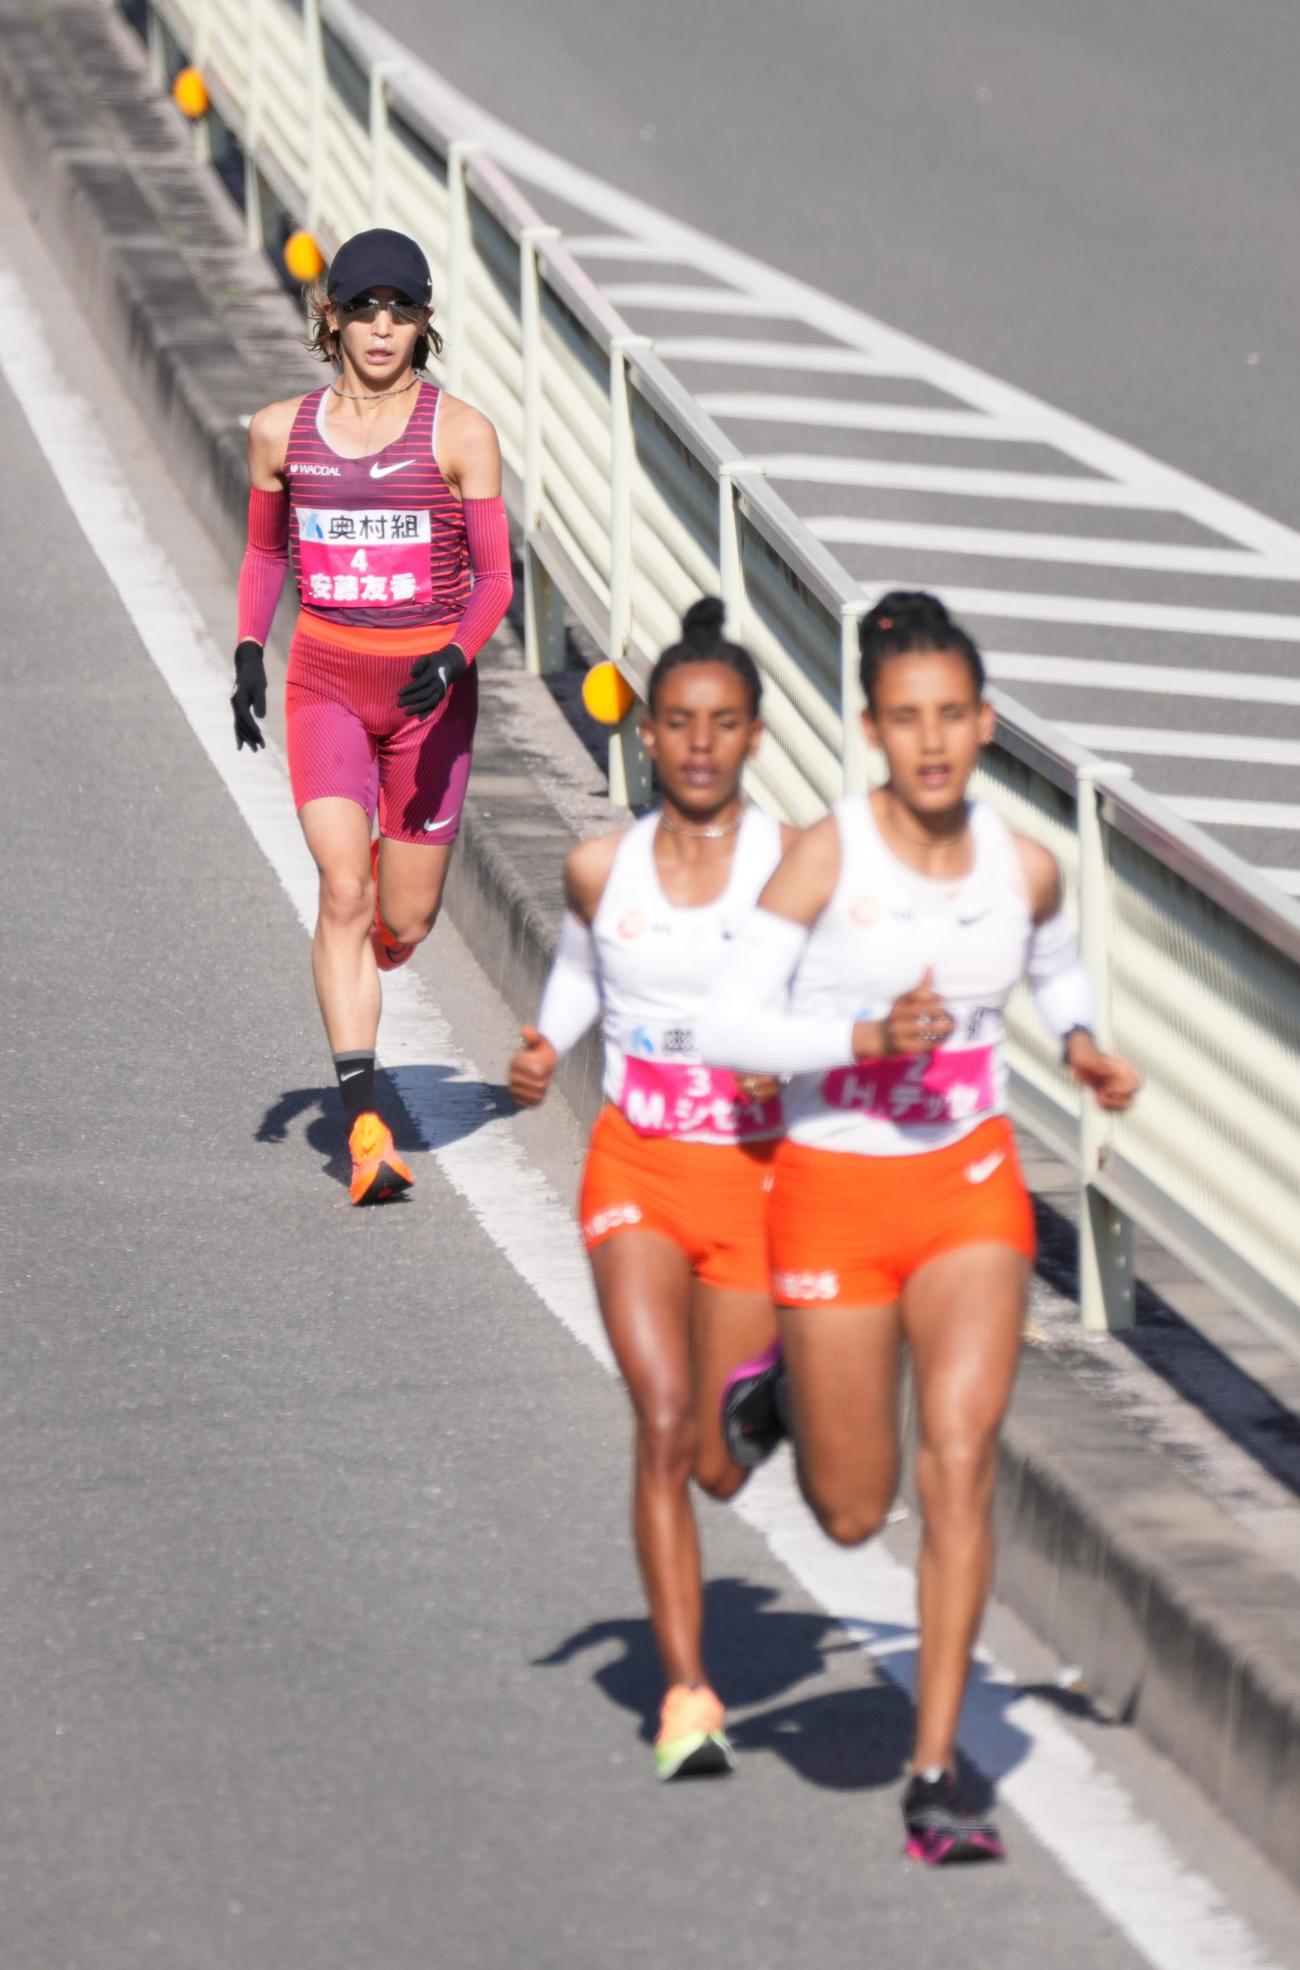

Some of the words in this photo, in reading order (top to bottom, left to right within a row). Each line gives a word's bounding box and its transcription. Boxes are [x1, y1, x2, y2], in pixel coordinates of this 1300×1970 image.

[300, 464, 341, 476] WACOAL
[328, 515, 420, 539] 奥村組
[351, 548, 368, 572] 4
[685, 1067, 711, 1097] 3
